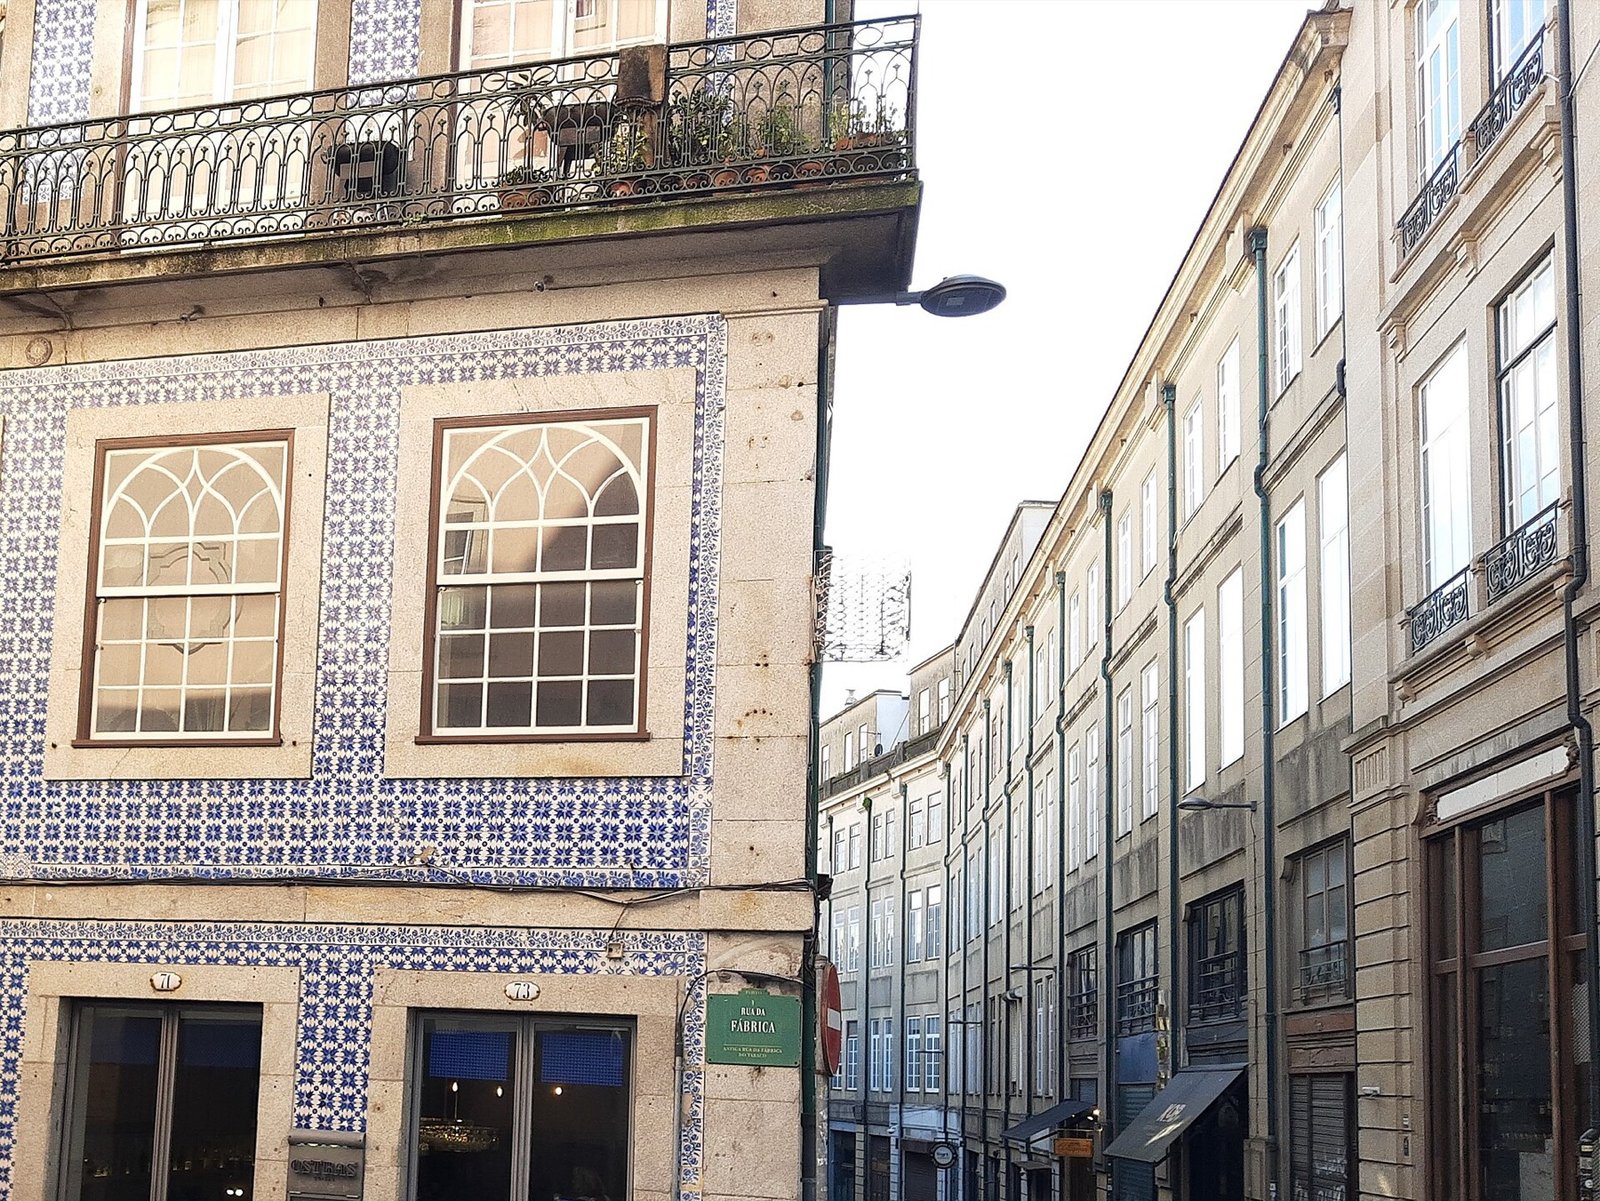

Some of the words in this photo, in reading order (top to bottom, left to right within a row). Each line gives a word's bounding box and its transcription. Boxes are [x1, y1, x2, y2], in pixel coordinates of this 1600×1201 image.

[160, 973, 171, 989] 71
[514, 983, 530, 999] 73
[741, 1007, 755, 1016] RUA
[756, 1007, 766, 1016] DA
[731, 1018, 775, 1033] FÁBRICA
